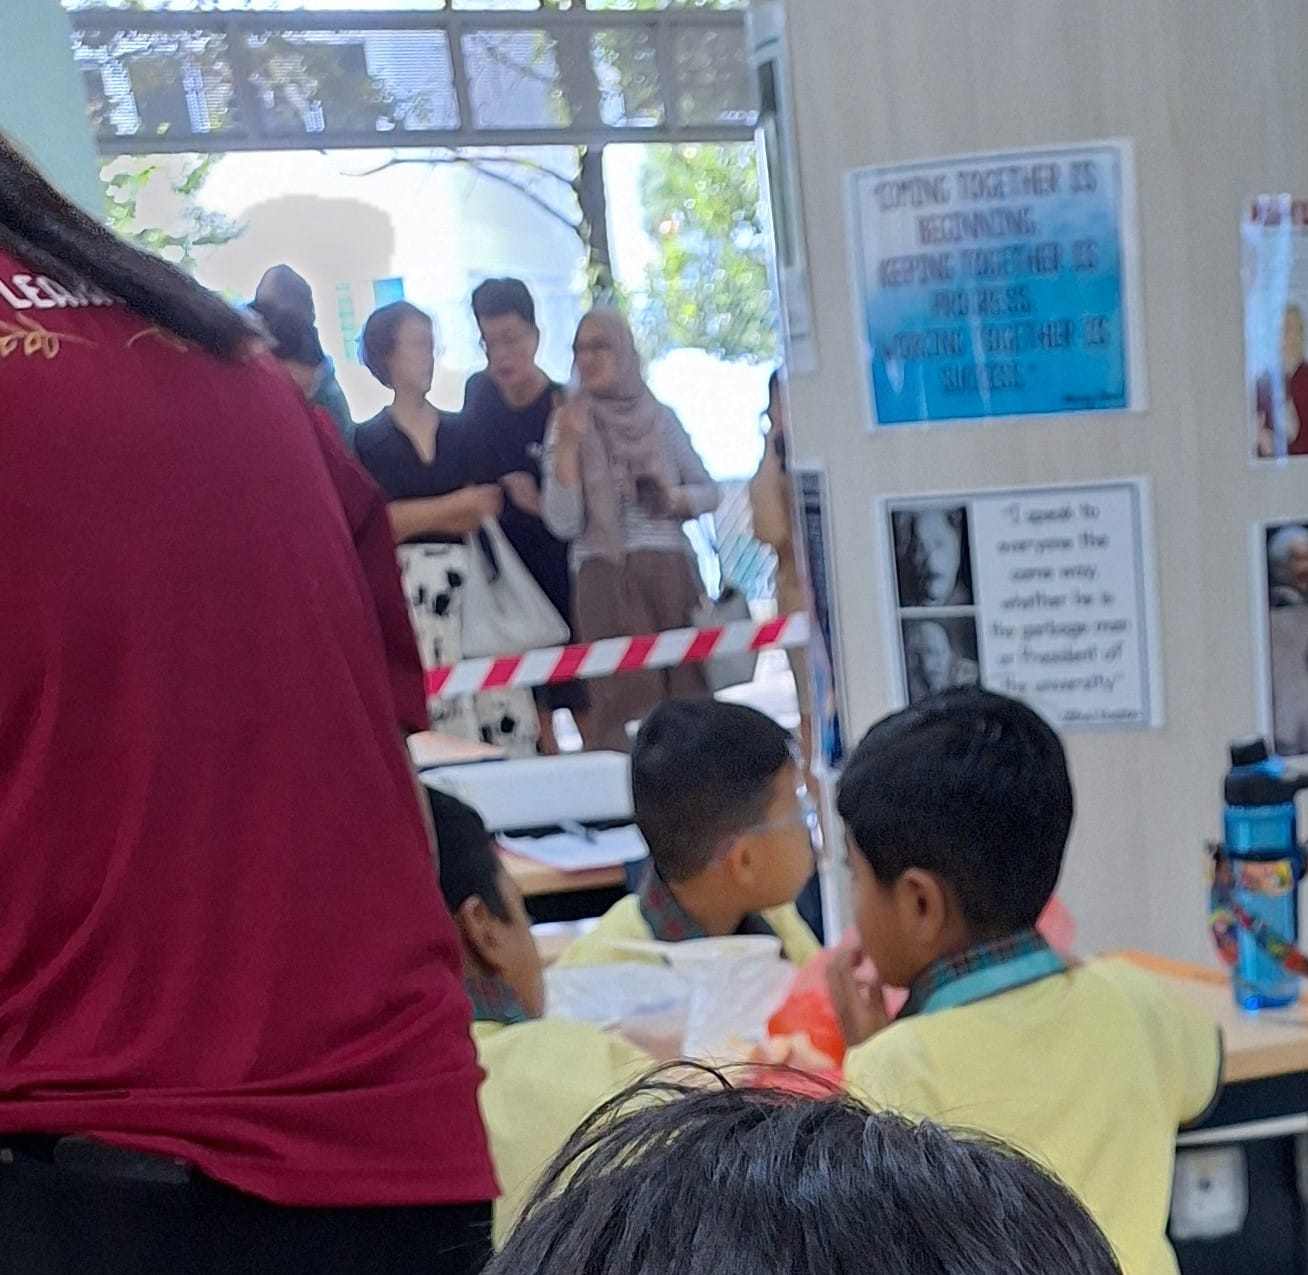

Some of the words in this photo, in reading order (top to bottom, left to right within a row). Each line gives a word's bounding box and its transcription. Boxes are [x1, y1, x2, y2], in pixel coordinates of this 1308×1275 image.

[957, 164, 1059, 201] TOGETHER
[1069, 159, 1098, 194] IS
[879, 252, 953, 288] KEEPING
[959, 241, 1062, 280] TOGETHER
[1070, 238, 1098, 273] IS
[969, 318, 1075, 355] OGETHER
[1083, 313, 1113, 347] IS
[1027, 505, 1074, 527] speak
[1079, 502, 1101, 521] to
[996, 537, 1074, 559] everyone
[1078, 529, 1110, 551] the
